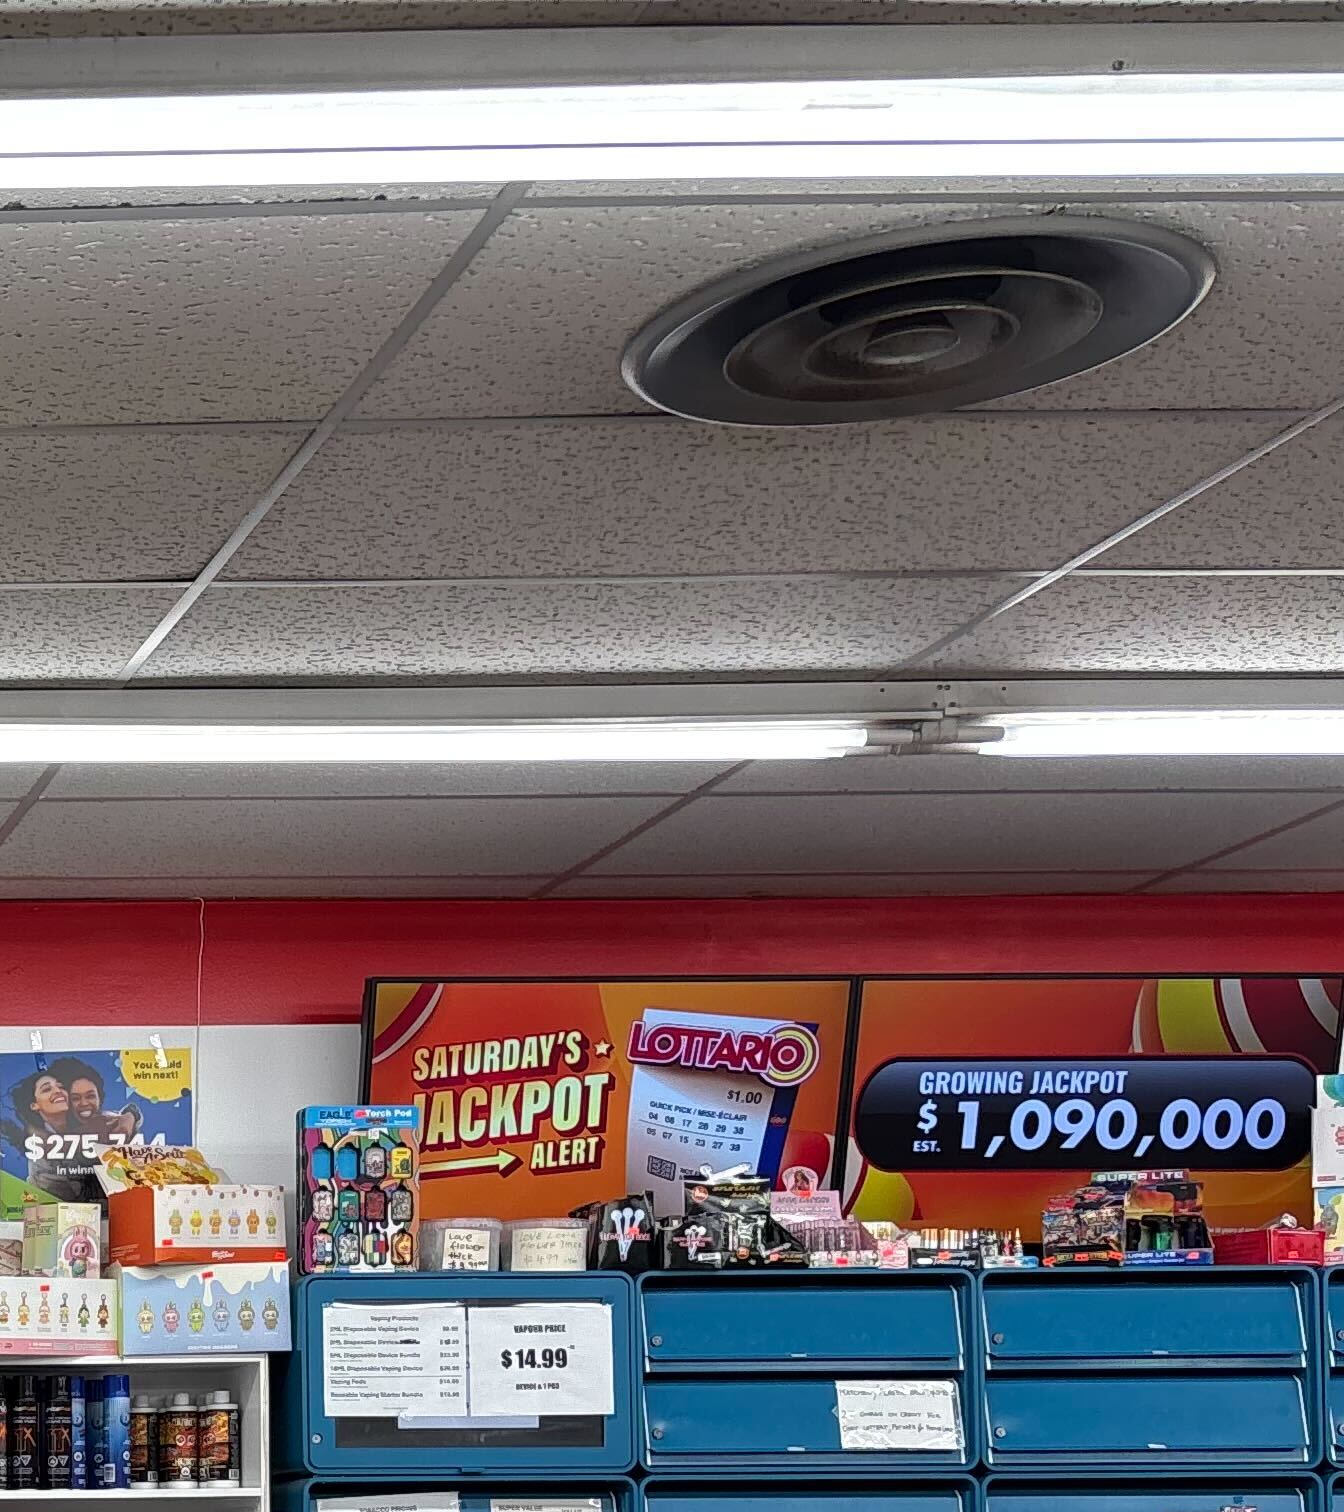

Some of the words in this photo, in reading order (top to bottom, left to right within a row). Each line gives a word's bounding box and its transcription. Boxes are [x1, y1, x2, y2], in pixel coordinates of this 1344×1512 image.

[413, 1030, 584, 1082] SATURDAY'S
[629, 1022, 817, 1085] LOTTARIO
[133, 1062, 151, 1070] You
[134, 1072, 150, 1080] win
[153, 1071, 179, 1080] next!
[919, 1071, 1023, 1095] GROWING
[1031, 1070, 1128, 1094] JACKPOT
[727, 1090, 762, 1104] $1.00
[394, 1109, 412, 1117] Pod
[415, 1074, 609, 1147] JACKPOT
[650, 1101, 672, 1112] QUICK
[674, 1105, 692, 1115] PICK
[917, 1100, 938, 1132] $
[958, 1099, 1286, 1157] 1,090,000
[913, 1140, 941, 1152] EST.
[531, 1139, 601, 1170] ALERT
[56, 1166, 66, 1175] in
[1096, 1172, 1146, 1183] SUPER
[1151, 1170, 1184, 1180] LITE
